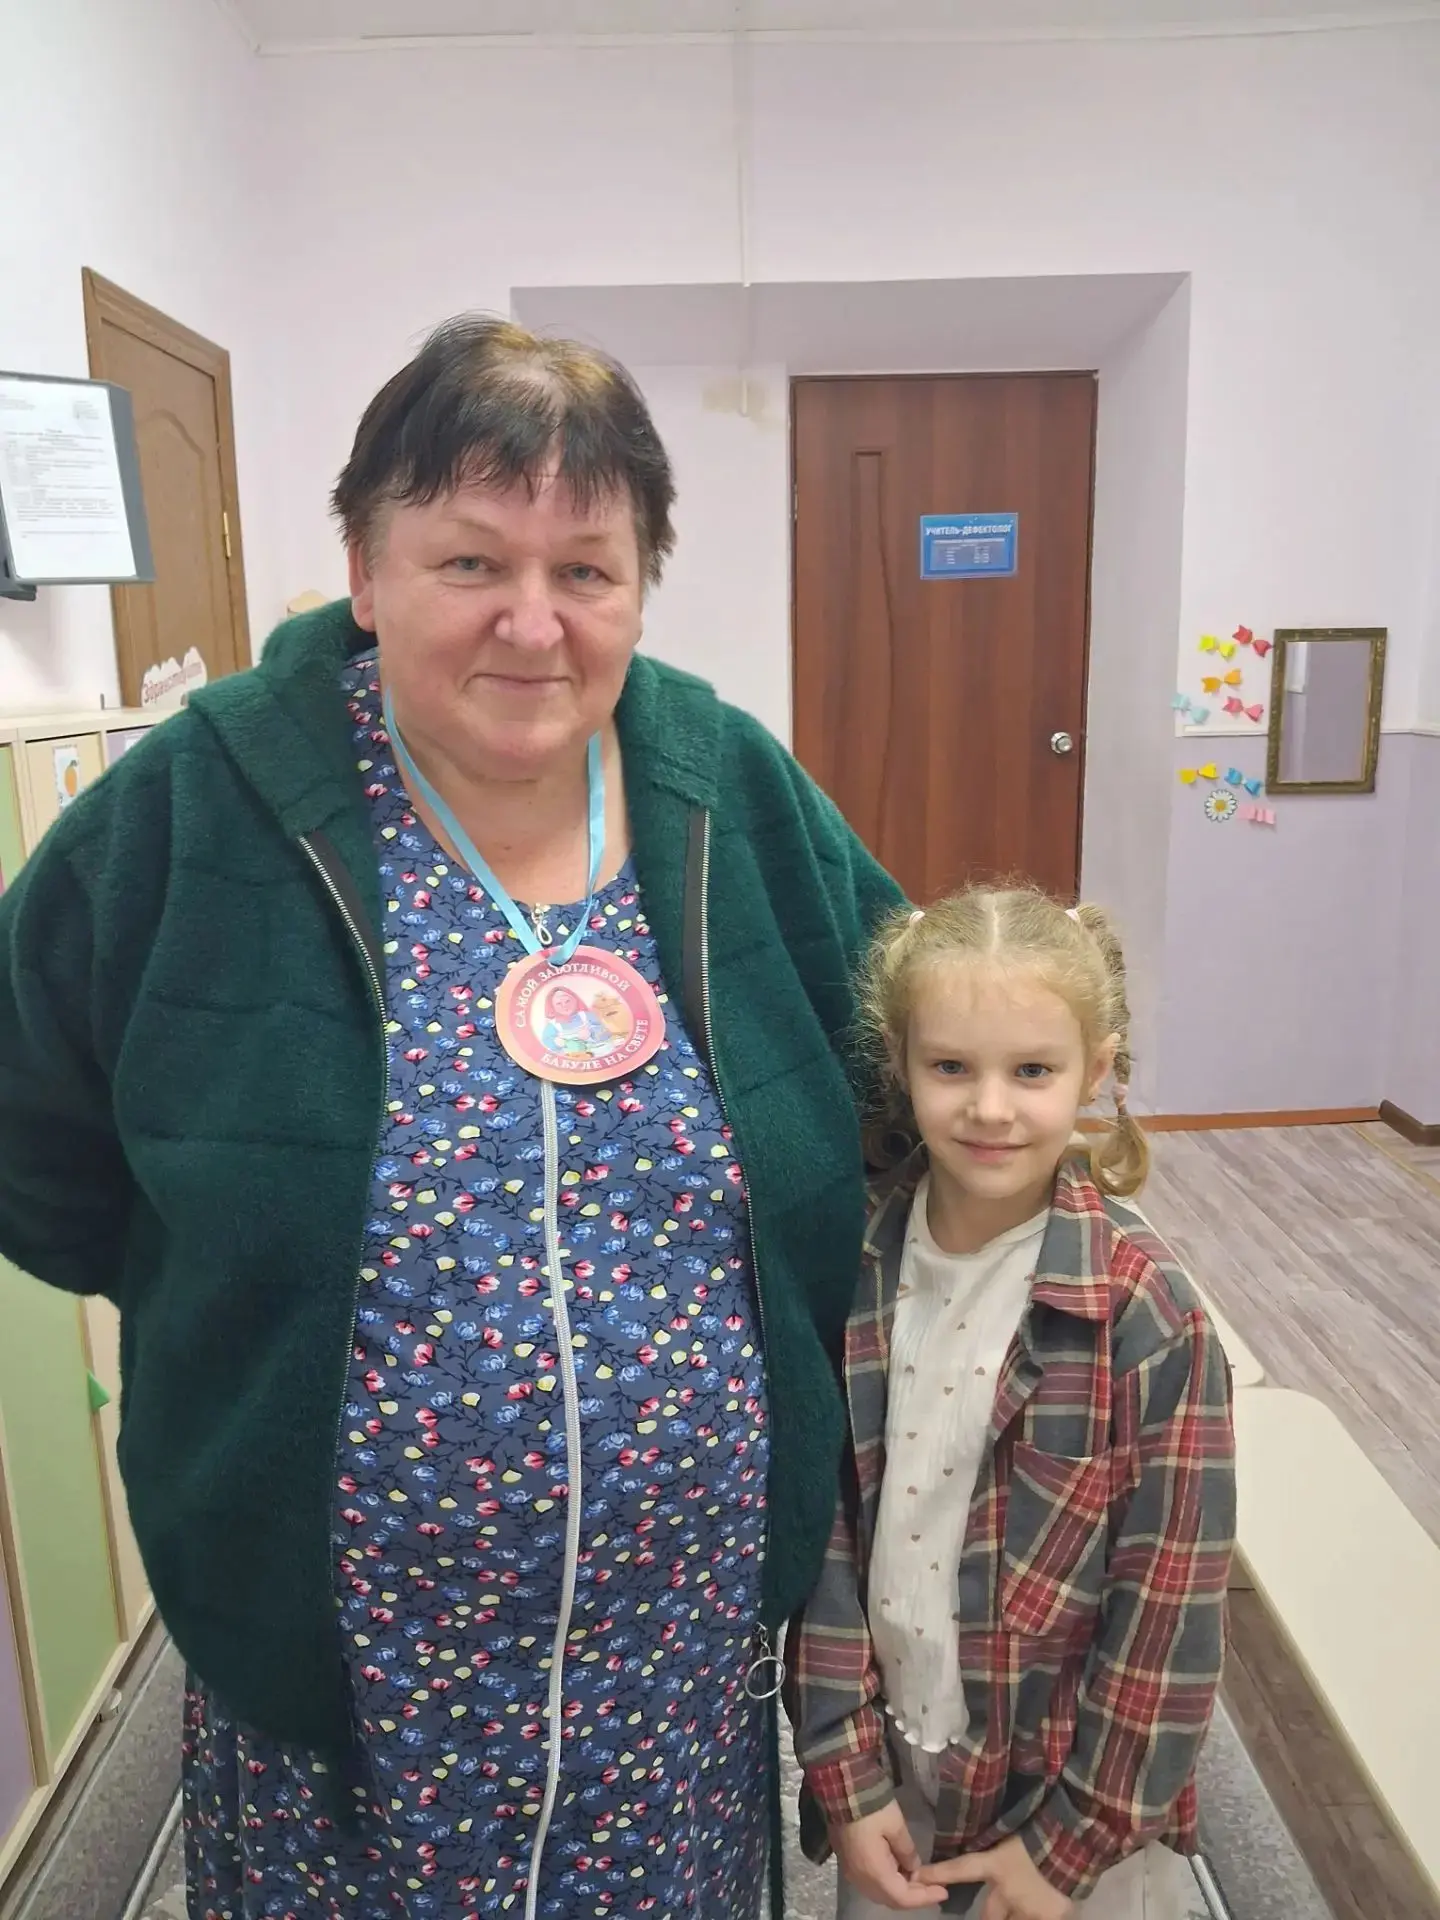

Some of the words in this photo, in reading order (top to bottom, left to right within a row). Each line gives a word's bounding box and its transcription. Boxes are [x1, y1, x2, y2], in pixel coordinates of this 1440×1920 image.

[514, 978, 539, 1028] САМОЙ
[540, 1052, 601, 1070] БАБУЛЕ
[605, 1050, 628, 1066] НА
[625, 1019, 649, 1053] СВЕТЕ
